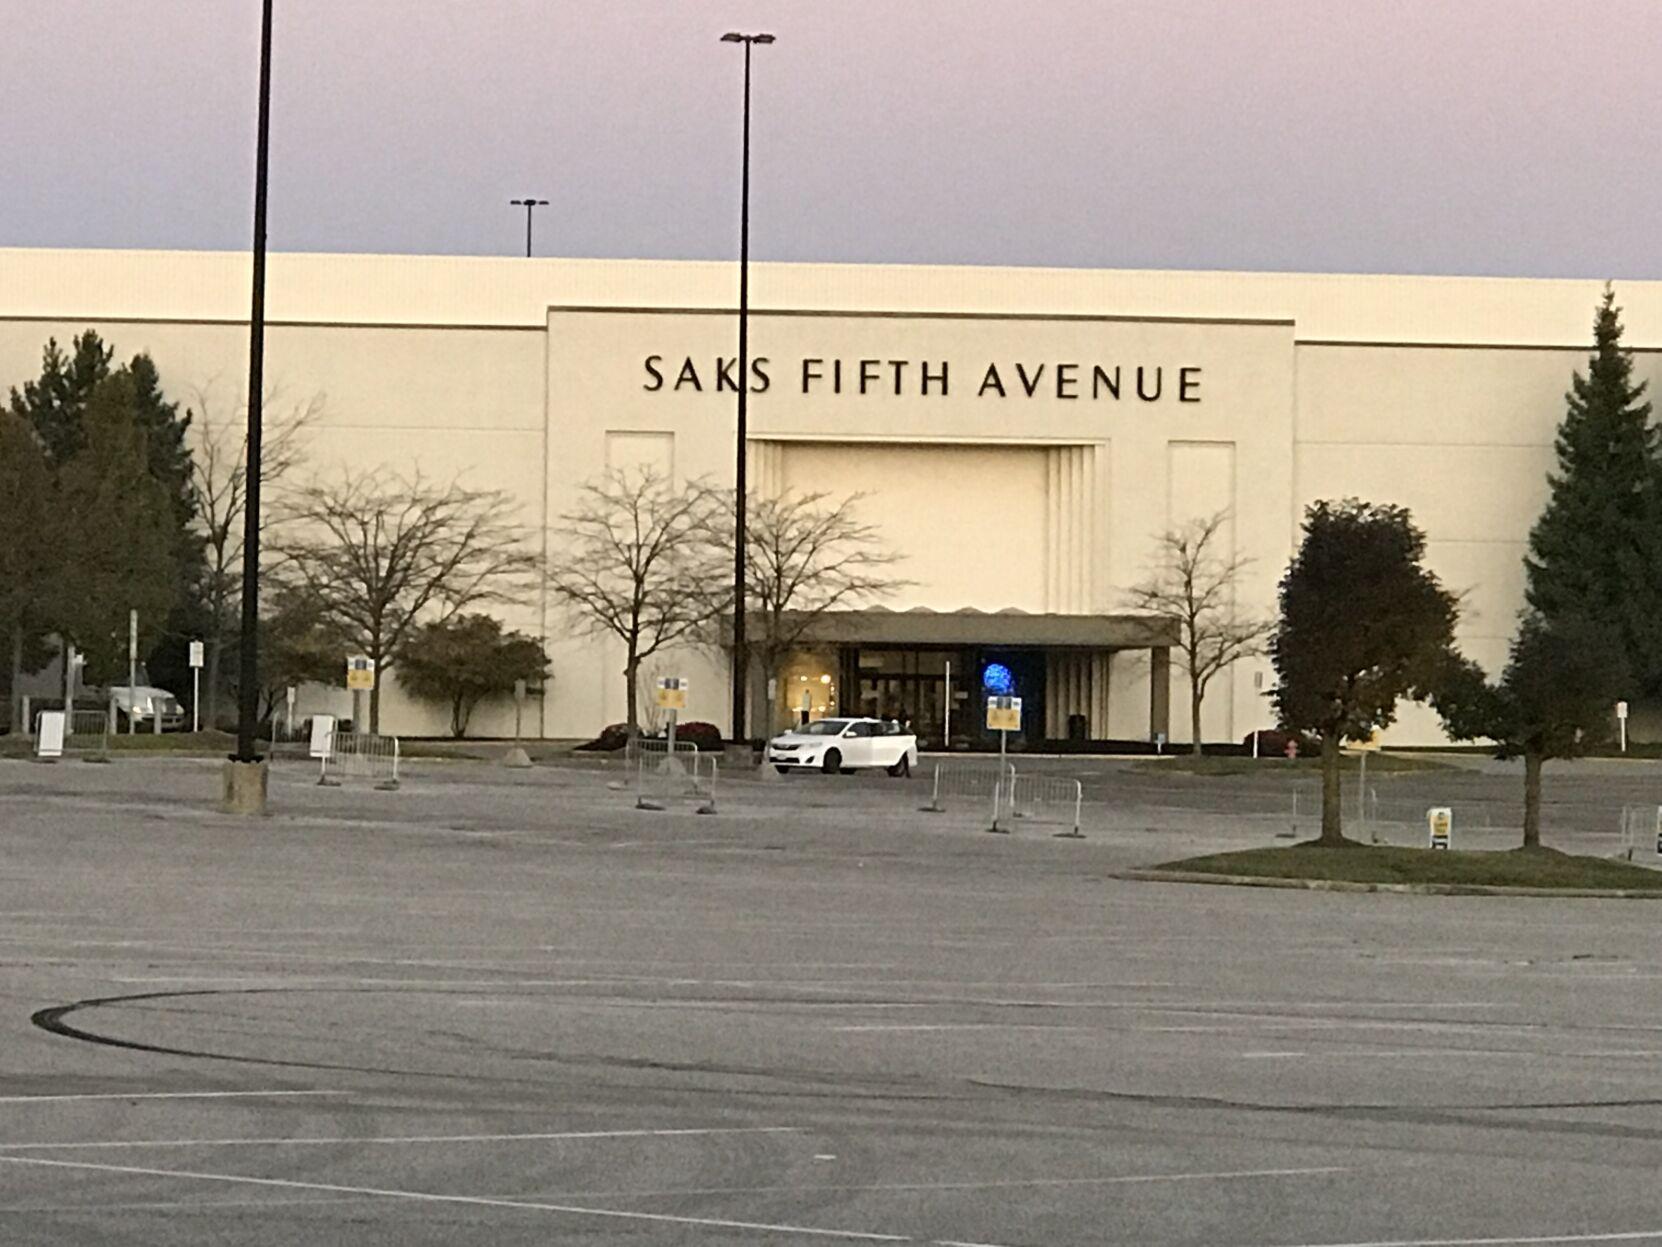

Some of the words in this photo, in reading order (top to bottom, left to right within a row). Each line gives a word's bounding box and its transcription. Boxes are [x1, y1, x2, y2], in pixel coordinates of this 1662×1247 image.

[643, 354, 770, 393] SAKS
[801, 358, 949, 397] FIFTH
[978, 362, 1203, 403] AVENUE
